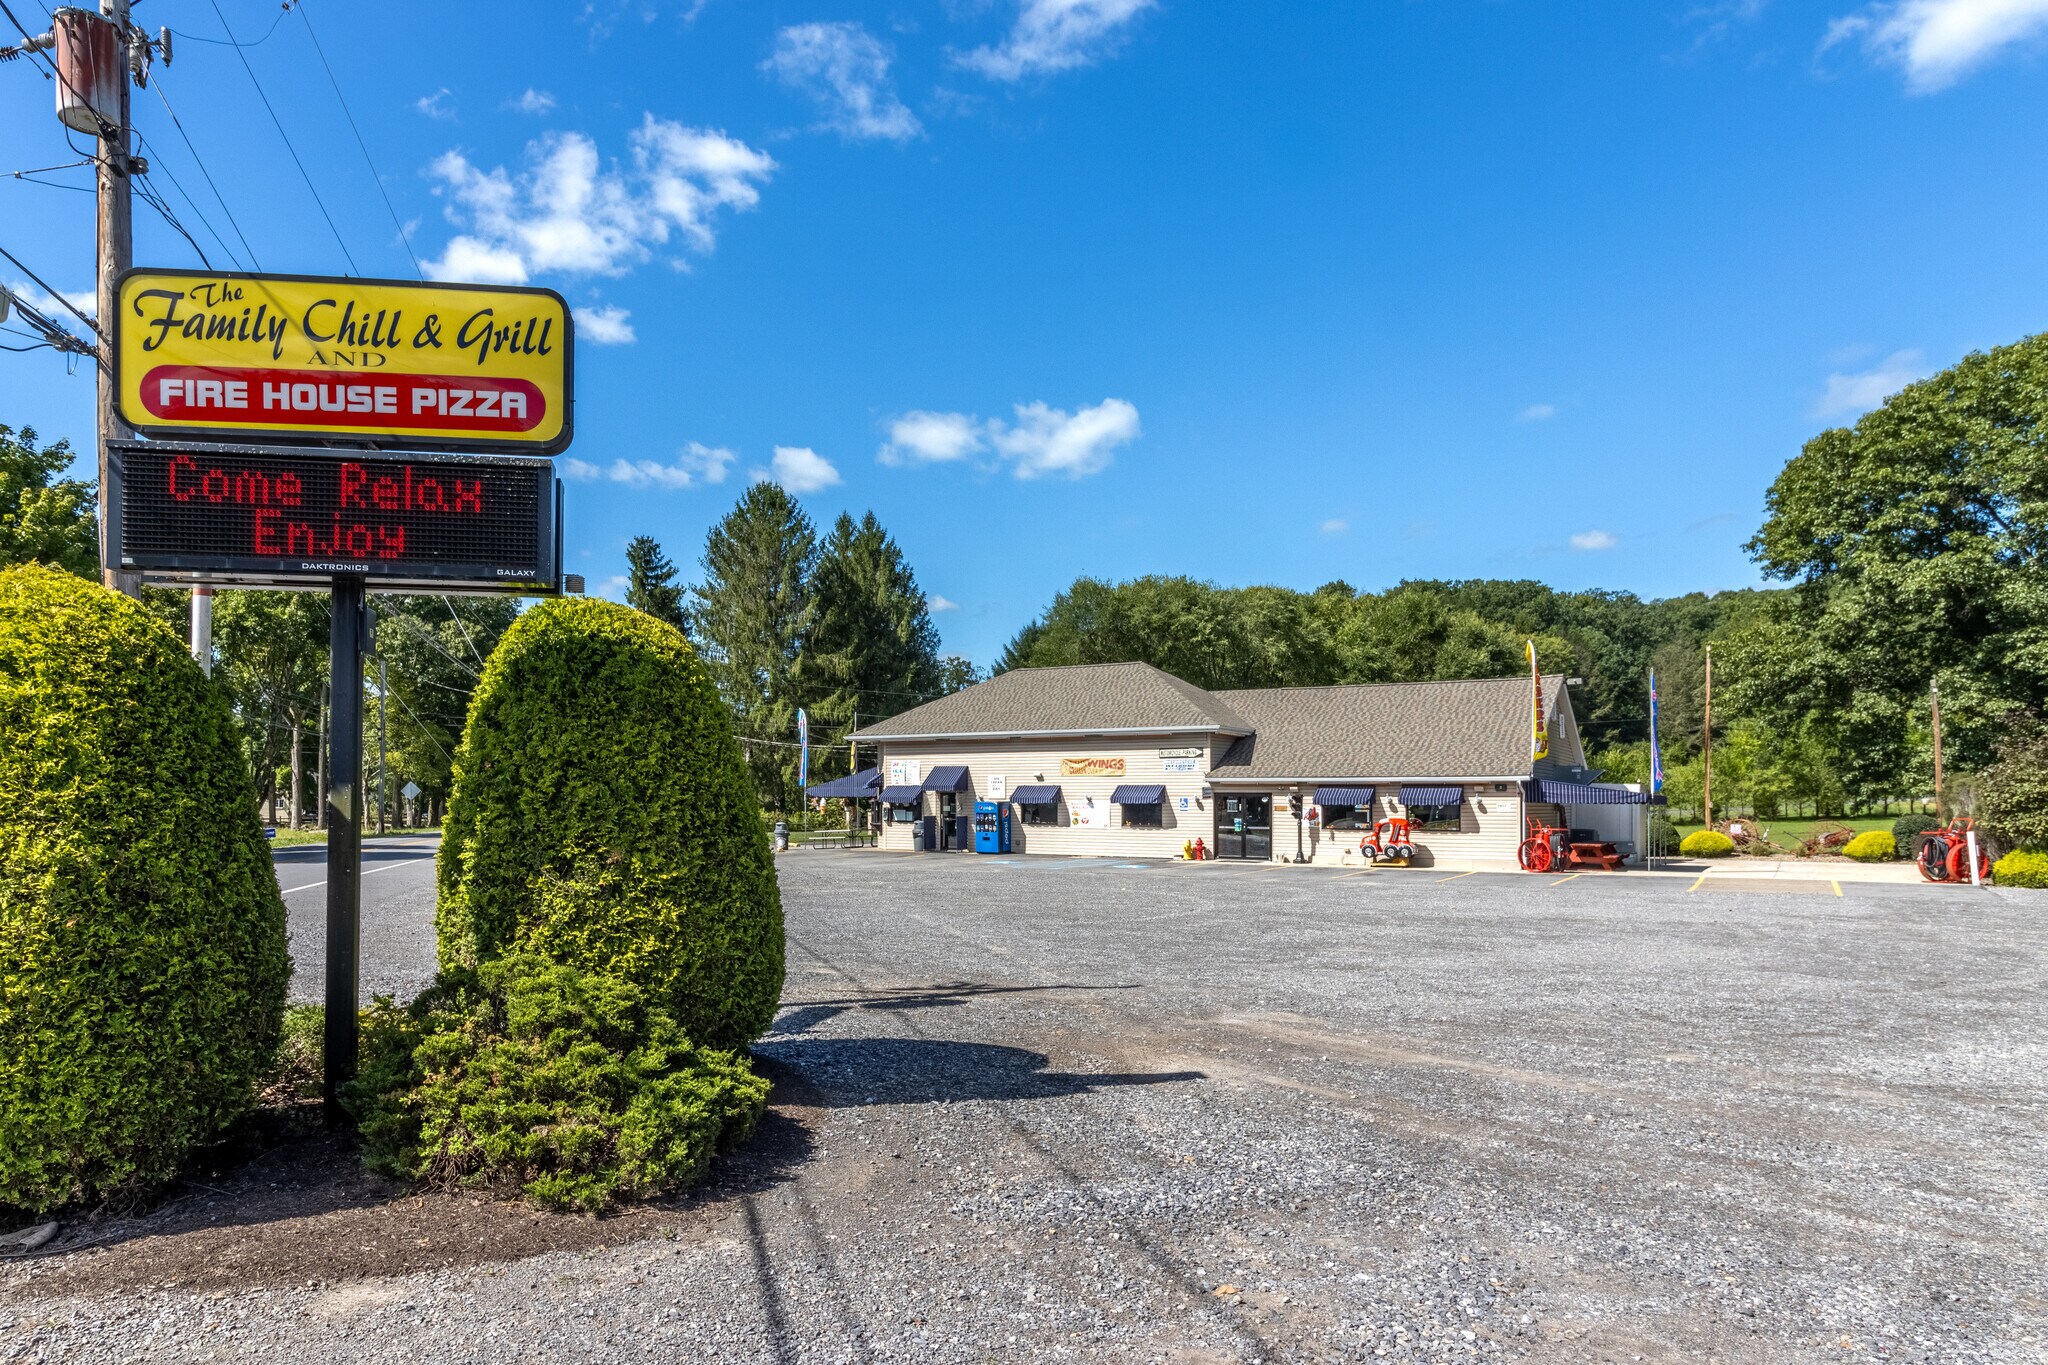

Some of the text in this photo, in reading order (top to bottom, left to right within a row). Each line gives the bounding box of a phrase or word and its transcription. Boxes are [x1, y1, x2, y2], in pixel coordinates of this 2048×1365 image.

[190, 281, 244, 308] The
[133, 288, 553, 365] Family Chill & Grill
[307, 350, 387, 368] AND
[159, 378, 527, 419] FIRE HOUSE PIZZA
[169, 455, 482, 513] Come Relax
[255, 509, 405, 559] Enjoy
[301, 562, 369, 572] DAKTRONICS
[496, 568, 536, 577] GALAXY
[1087, 758, 1125, 770] WINGS
